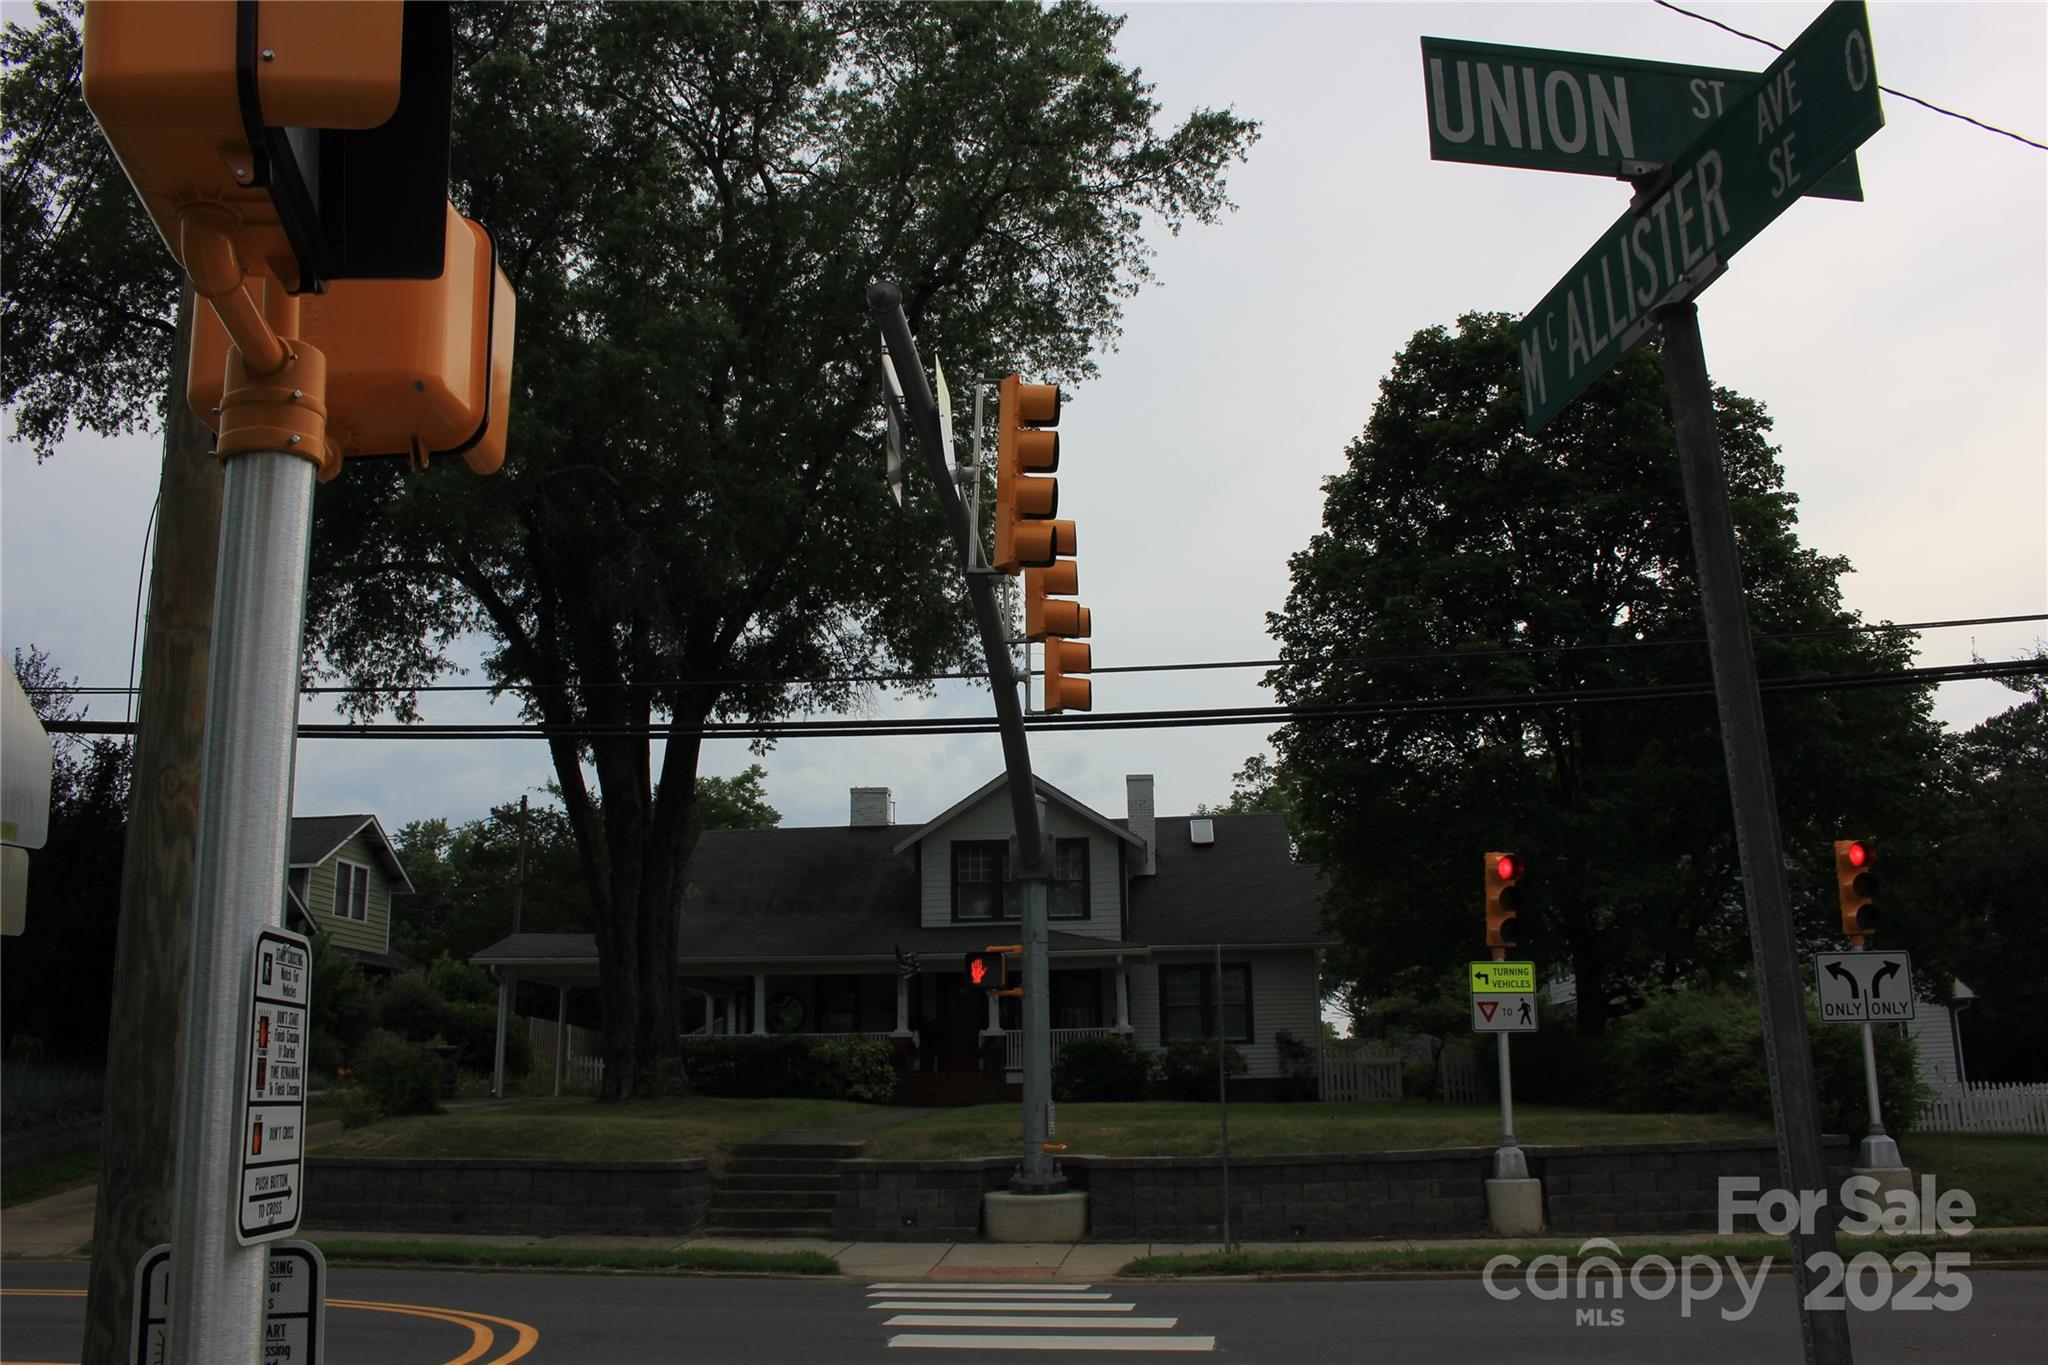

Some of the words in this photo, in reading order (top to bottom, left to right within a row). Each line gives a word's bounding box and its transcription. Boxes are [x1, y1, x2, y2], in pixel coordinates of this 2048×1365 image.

[1430, 57, 1635, 159] UNION
[1692, 77, 1725, 121] ST
[1757, 59, 1803, 145] AVE
[1768, 131, 1801, 199] SE
[1493, 967, 1529, 977] TURNING
[1491, 979, 1531, 989] VEHICLES
[1502, 1007, 1513, 1016] TO
[1825, 1003, 1862, 1016] ONLY
[1871, 1002, 1908, 1015] ONLY
[255, 1176, 268, 1191] PUSH
[269, 1173, 289, 1189] BUTTON
[258, 1204, 265, 1218] TO
[265, 1201, 283, 1217] CROSS
